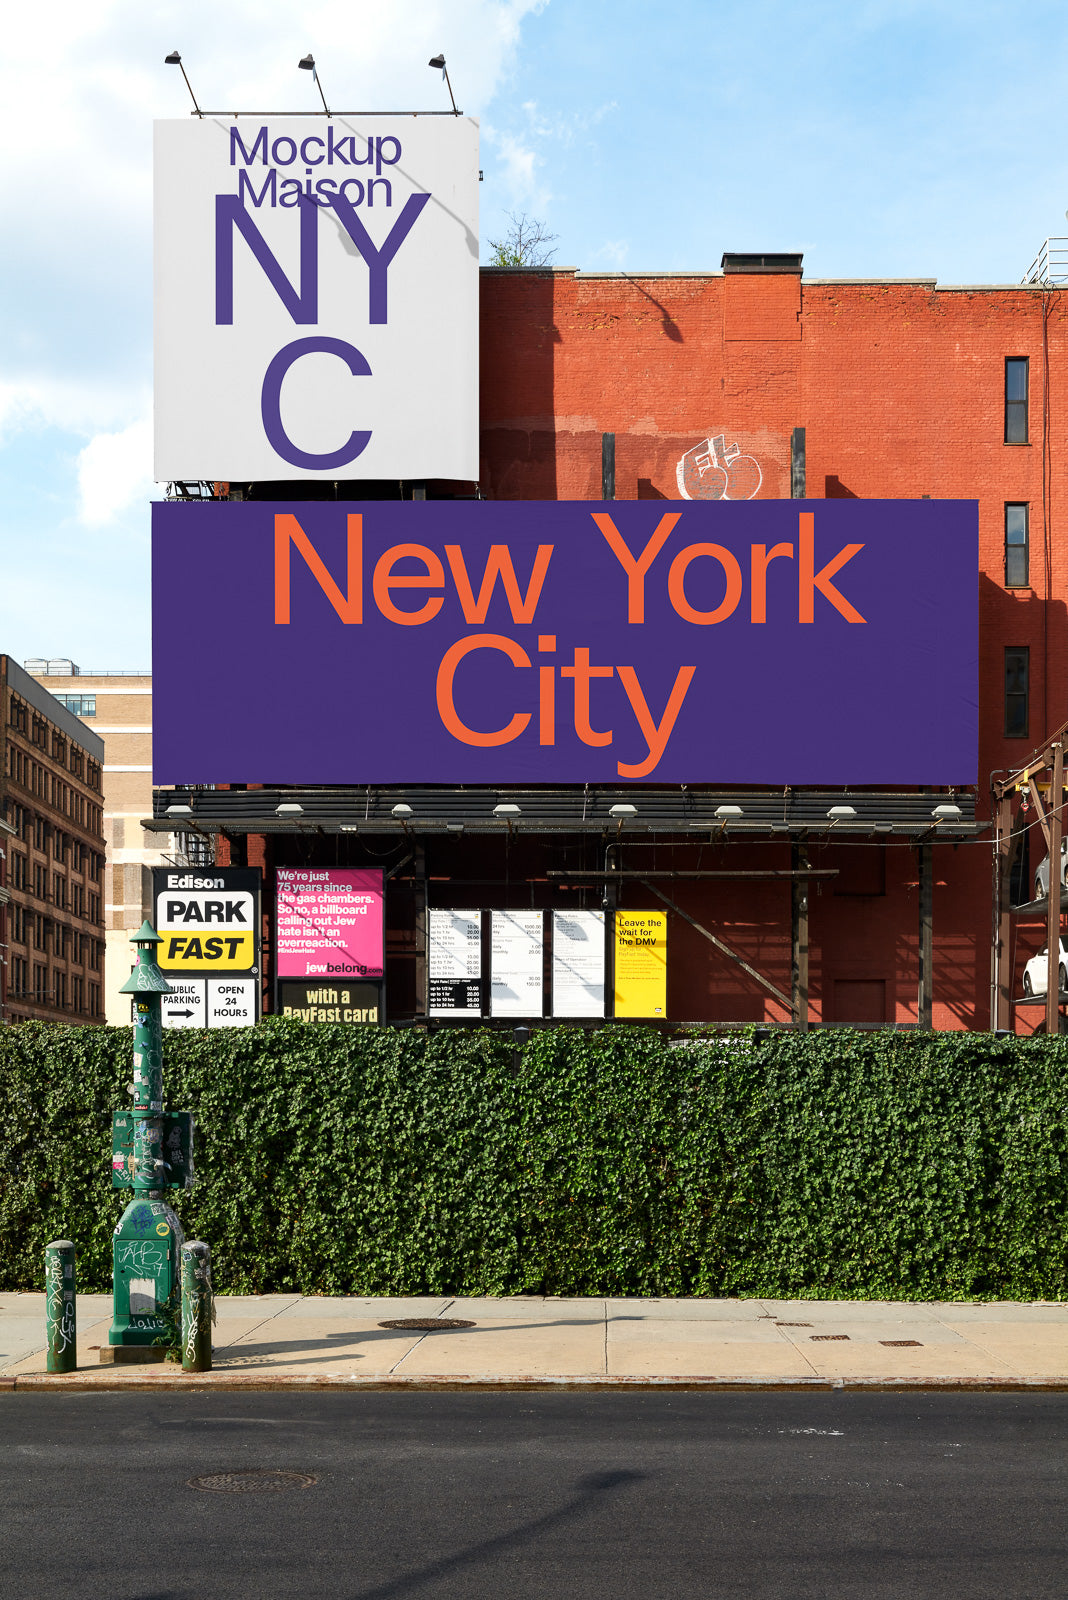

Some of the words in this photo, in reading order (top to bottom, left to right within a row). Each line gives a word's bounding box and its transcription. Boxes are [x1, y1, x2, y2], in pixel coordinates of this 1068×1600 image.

[230, 126, 402, 175] Mockup
[238, 169, 392, 208] Maison
[215, 192, 432, 325] NY
[261, 336, 373, 470] C
[274, 513, 554, 626] New
[591, 512, 867, 626] York
[436, 633, 697, 778] City
[167, 874, 224, 888] Edison
[277, 871, 308, 881] We're
[309, 871, 329, 882] just
[278, 882, 291, 892] 75
[293, 884, 323, 893] years
[324, 882, 352, 892] since
[278, 893, 295, 903] the
[297, 896, 316, 904] gas
[317, 893, 374, 903] chambers.
[167, 901, 247, 922] PARK
[278, 904, 293, 914] So
[294, 906, 310, 915] no,
[320, 905, 367, 914] billboard
[278, 916, 312, 927] calling
[314, 916, 332, 925] out
[333, 916, 356, 925] Jew
[619, 919, 645, 927] Leave
[647, 919, 661, 927] the
[278, 926, 301, 936] hate
[303, 927, 325, 936] isn't
[326, 928, 340, 936] an
[619, 928, 637, 936] wait
[639, 928, 652, 936] for
[278, 938, 348, 948] overreaction.
[635, 938, 656, 946] DMV
[167, 937, 244, 960] FAST
[305, 962, 383, 975] jewbelong.com
[218, 986, 244, 994] OPEN
[163, 995, 200, 1004] PARKING
[225, 997, 237, 1005] 24
[306, 988, 338, 1004] with
[341, 990, 350, 1004] a
[214, 1009, 248, 1017] HOURS
[284, 1006, 341, 1023] PayFast
[343, 1006, 378, 1022] card
